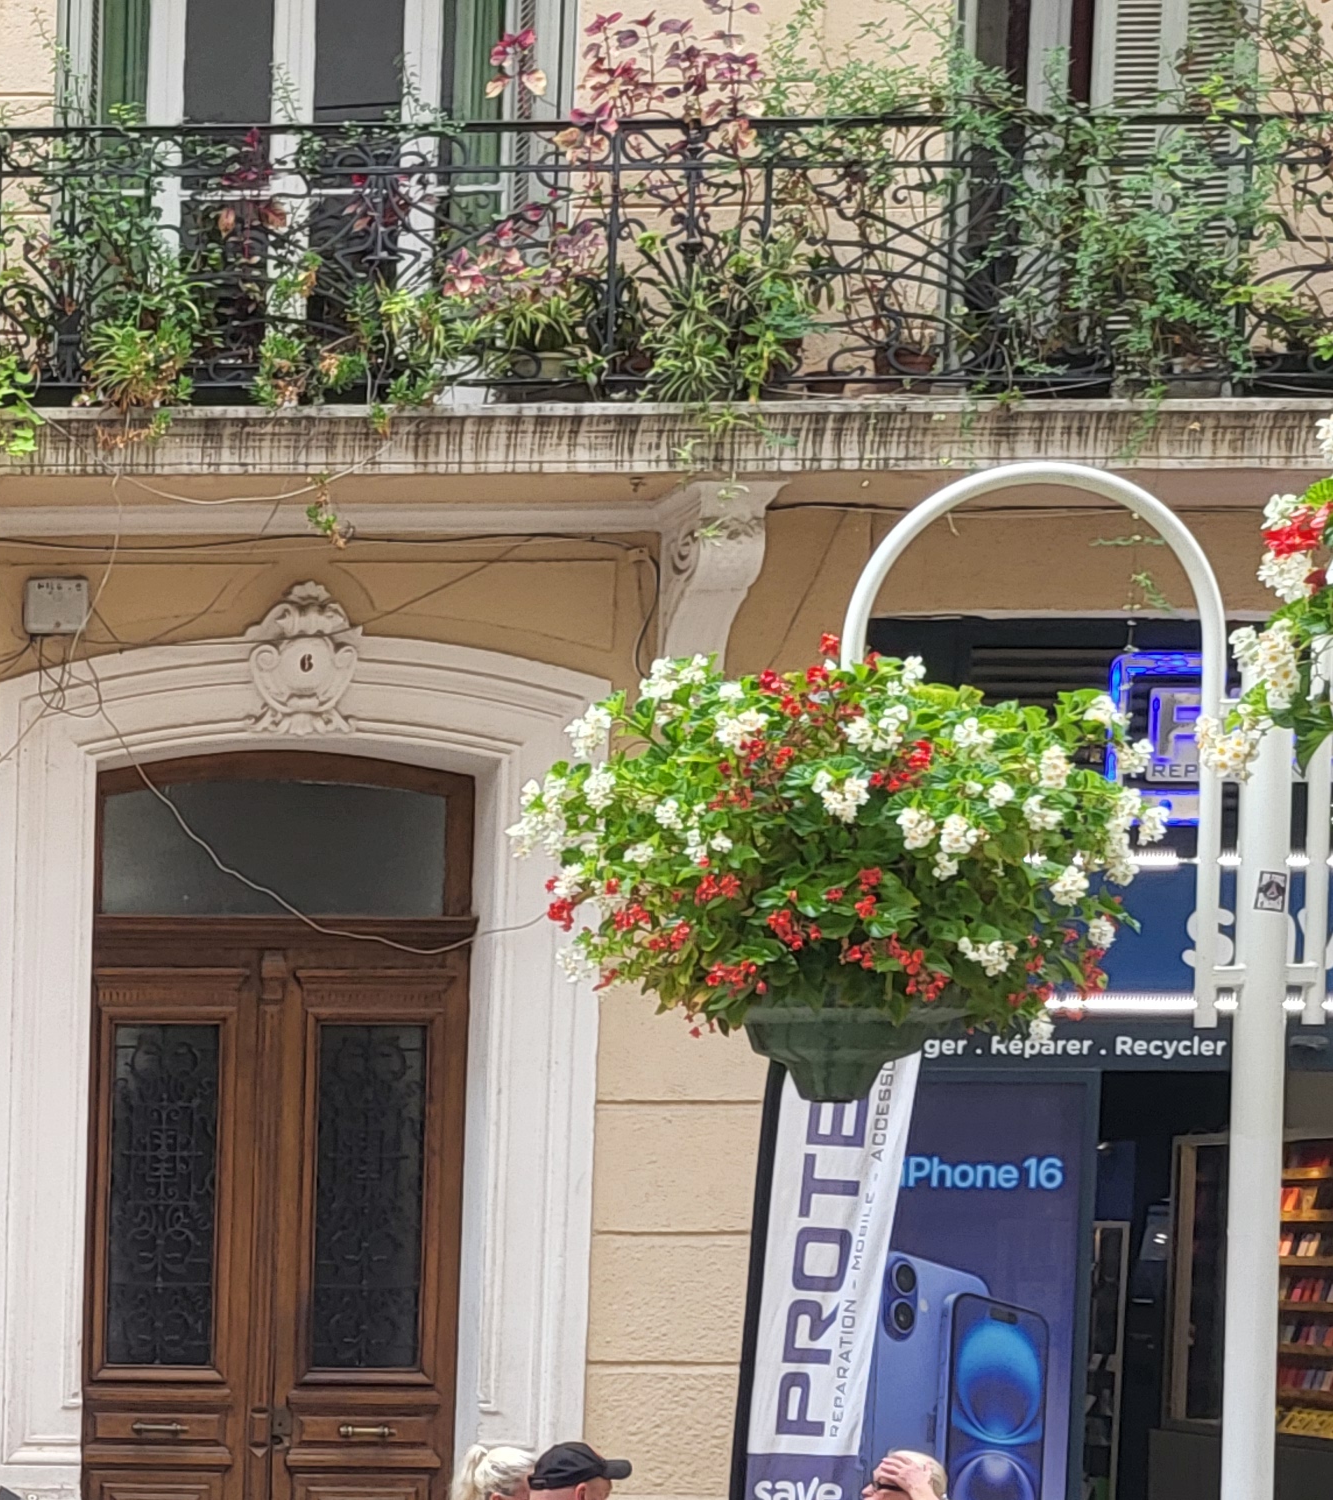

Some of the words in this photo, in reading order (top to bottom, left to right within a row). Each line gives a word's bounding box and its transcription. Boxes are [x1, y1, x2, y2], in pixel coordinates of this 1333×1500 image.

[299, 653, 314, 673] 6
[990, 1034, 1093, 1058] Réparer
[1115, 1036, 1227, 1060] Recycler
[1022, 1156, 1064, 1189] 16
[850, 1192, 877, 1271] MOBILE
